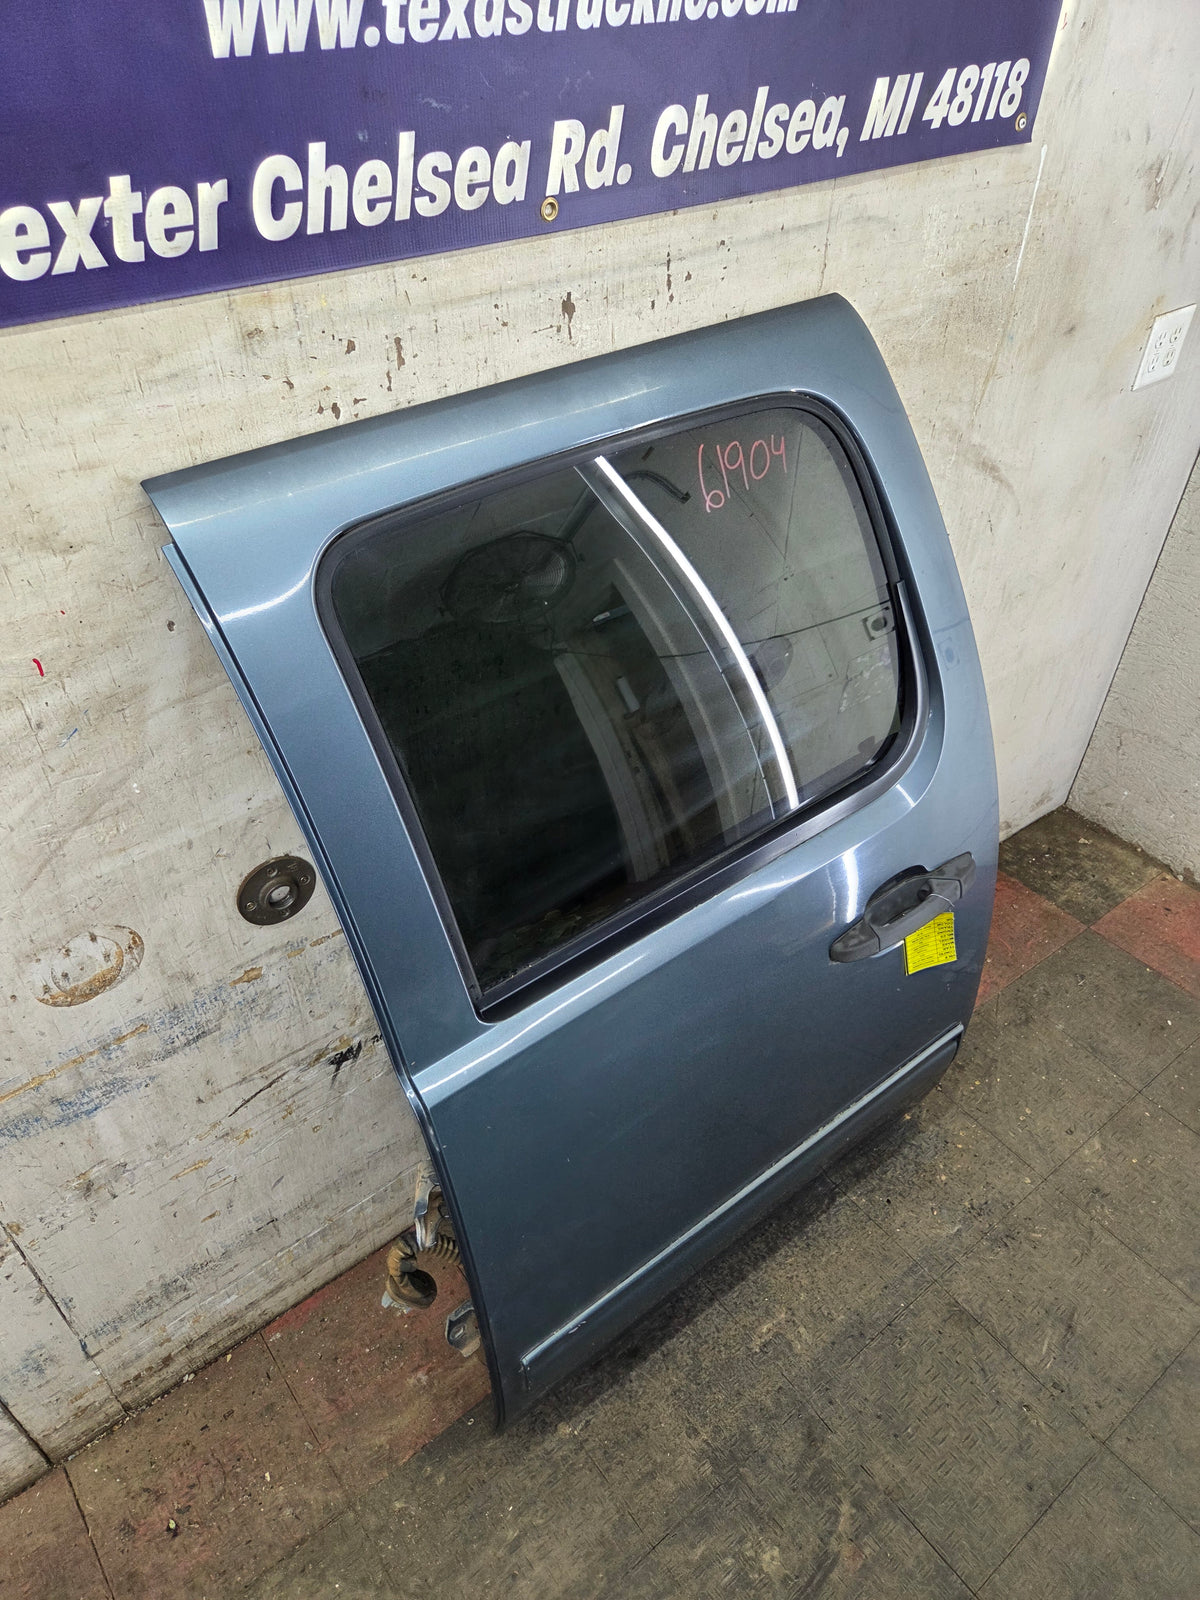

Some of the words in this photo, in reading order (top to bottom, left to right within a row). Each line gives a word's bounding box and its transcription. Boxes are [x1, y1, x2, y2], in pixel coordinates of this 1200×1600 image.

[251, 130, 532, 242] Chelsea
[544, 104, 633, 198] Rd.
[650, 85, 849, 179] Chelsea,
[859, 72, 924, 143] MI
[923, 57, 1031, 130] 48118
[698, 434, 788, 513] 61904
